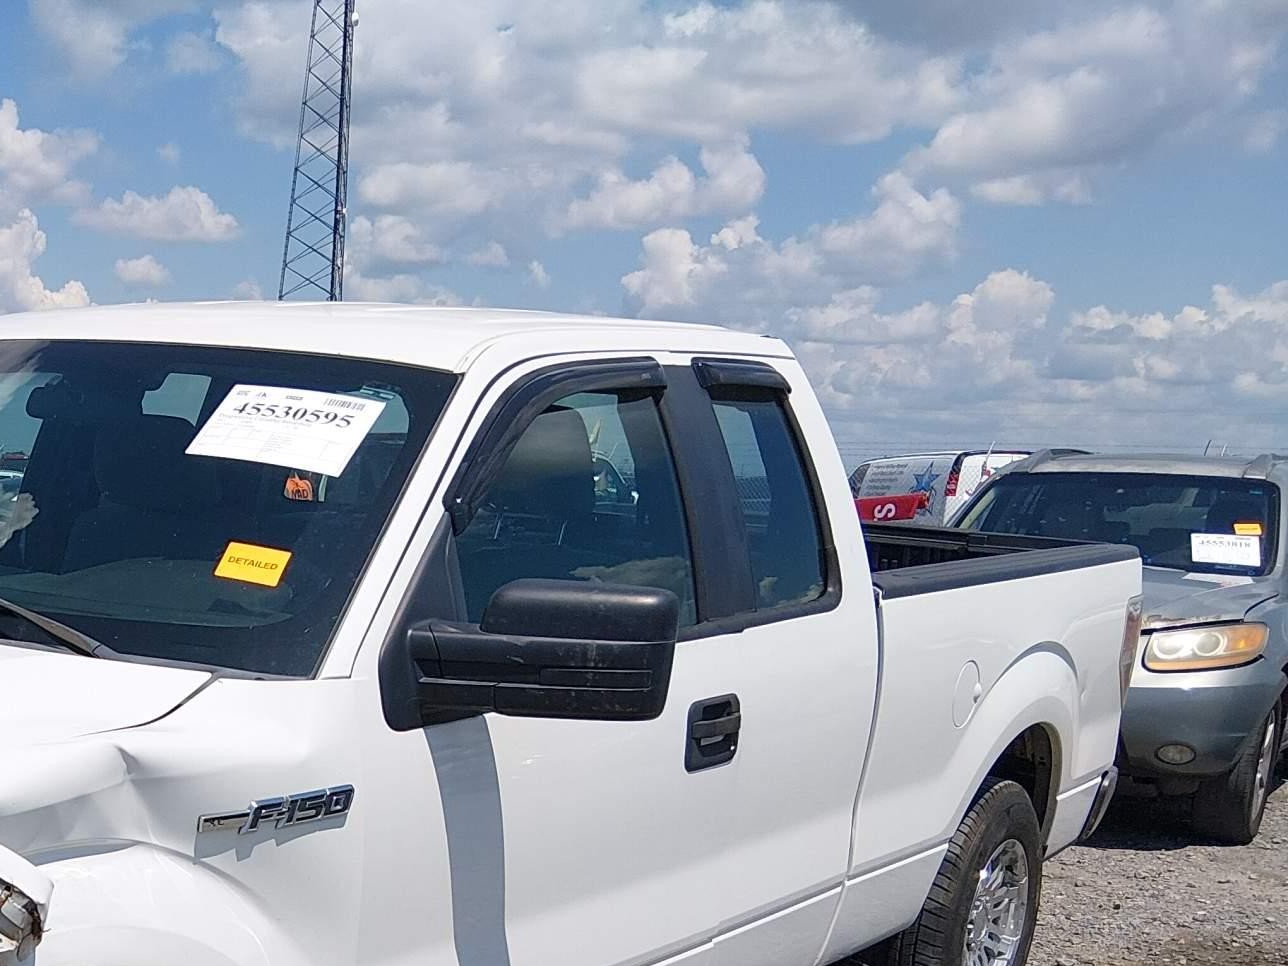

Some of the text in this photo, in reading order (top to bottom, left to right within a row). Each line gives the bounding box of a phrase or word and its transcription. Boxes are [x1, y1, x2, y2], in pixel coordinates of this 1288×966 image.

[233, 401, 355, 429] 45530595
[227, 555, 279, 570] DETAILED
[237, 784, 355, 834] F-150
